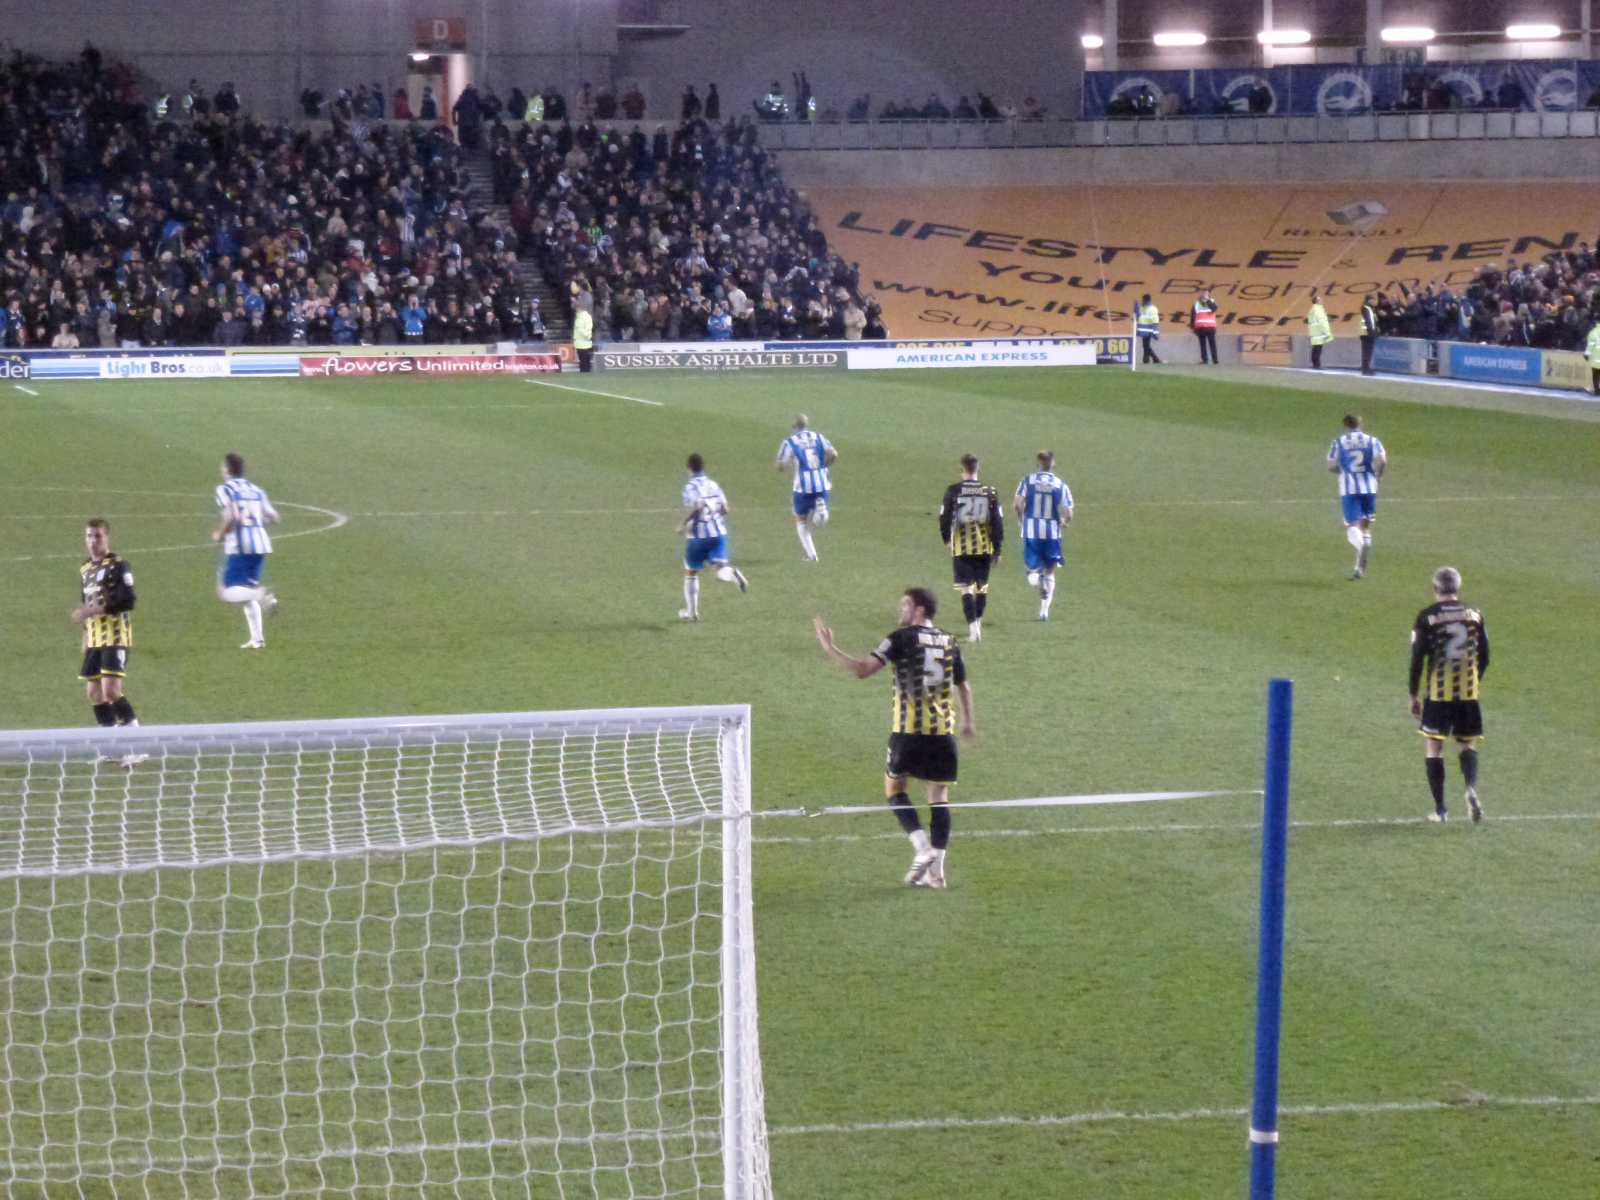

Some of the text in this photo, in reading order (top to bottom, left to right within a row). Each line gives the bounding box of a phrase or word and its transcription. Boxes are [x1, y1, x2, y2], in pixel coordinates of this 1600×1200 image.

[432, 19, 449, 40] D
[838, 211, 1307, 269] LIFESTYLE
[1332, 259, 1358, 269] &
[1283, 228, 1403, 237] RENAULT
[978, 259, 1144, 292] Your
[896, 352, 1049, 362] AMERICAN EXPRESS
[1107, 339, 1129, 354] 60
[107, 362, 146, 377] Light
[151, 361, 186, 374] Bros
[321, 356, 412, 376] flowers
[416, 359, 504, 371] Unlimited
[603, 352, 838, 367] SUSSEX ASPHALTE LTD
[1349, 450, 1366, 473] 2
[957, 496, 989, 522] 20
[1033, 494, 1053, 519] 11
[1445, 623, 1468, 659] 2
[923, 647, 945, 687] 5
